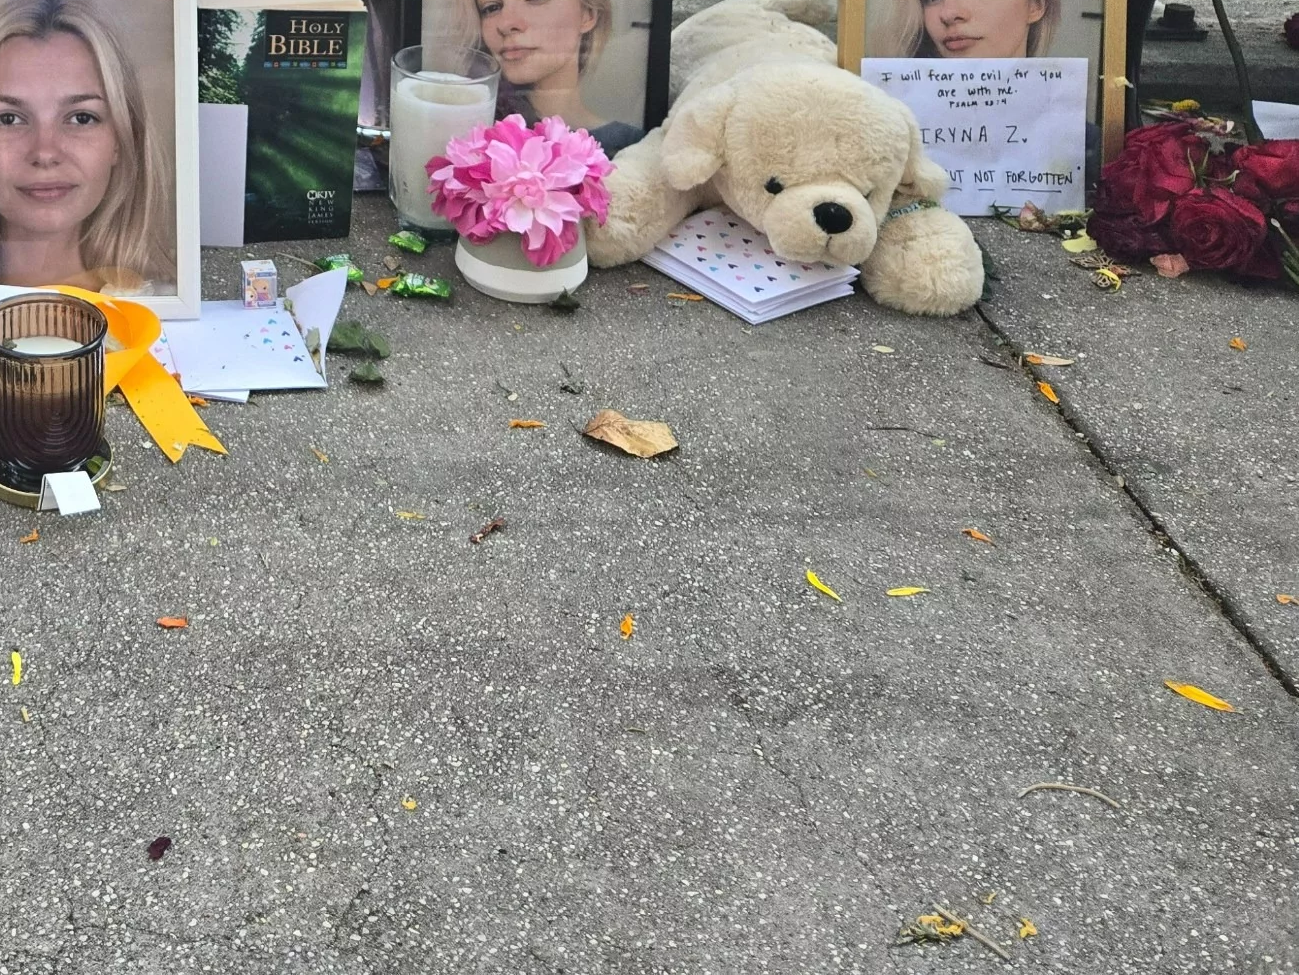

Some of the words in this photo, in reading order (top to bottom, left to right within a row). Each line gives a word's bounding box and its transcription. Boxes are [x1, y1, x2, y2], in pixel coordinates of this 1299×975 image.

[289, 19, 345, 34] HOLY
[267, 34, 343, 55] BIBLE
[881, 71, 893, 82] I
[900, 69, 921, 81] will
[928, 69, 955, 81] fear
[960, 72, 975, 81] no
[1014, 69, 1029, 79] for
[1039, 71, 1063, 82] you
[937, 88, 957, 97] are
[967, 85, 992, 96] with
[997, 84, 1018, 96] me.
[949, 99, 978, 108] PSALM
[920, 125, 988, 144] IRYNA
[974, 170, 996, 184] NOT
[1005, 170, 1073, 185] FORGOTTEN
